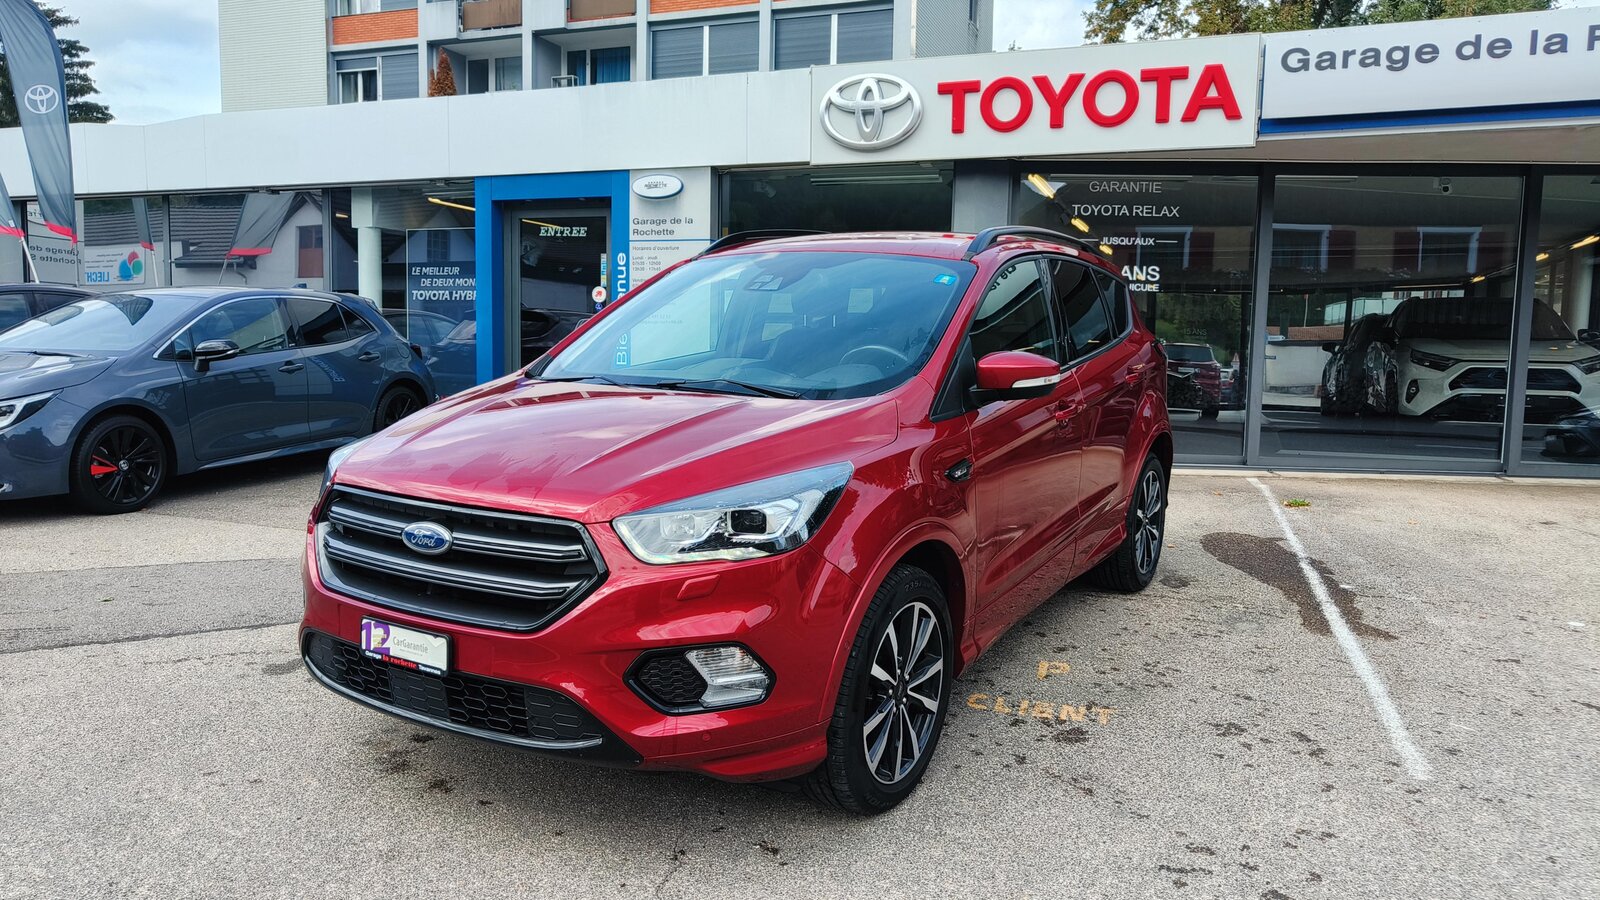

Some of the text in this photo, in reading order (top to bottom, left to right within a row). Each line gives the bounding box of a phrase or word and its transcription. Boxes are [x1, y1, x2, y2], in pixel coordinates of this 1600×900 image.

[1280, 42, 1440, 73] Garage
[1455, 33, 1512, 61] de
[1528, 29, 1568, 56] la
[937, 63, 1242, 134] TOYOTA
[1089, 181, 1162, 193] GARANTIE
[1072, 204, 1180, 217] TOYOTA RELAX
[632, 217, 667, 226] Garage
[670, 217, 682, 225] de
[538, 226, 588, 237] ENTREE
[632, 228, 675, 236] Rochette
[1100, 236, 1155, 246] JUSQU'AUX
[411, 267, 460, 276] LE MEILLEUR
[1121, 265, 1160, 281] ANS
[420, 278, 476, 287] DE DEUX MON
[411, 290, 451, 301] TOYOTA
[411, 529, 436, 547] Ford
[361, 621, 390, 655] 12
[393, 636, 429, 654] CarGarantie
[1036, 660, 1071, 681] P
[966, 693, 1118, 726] CLIENT
